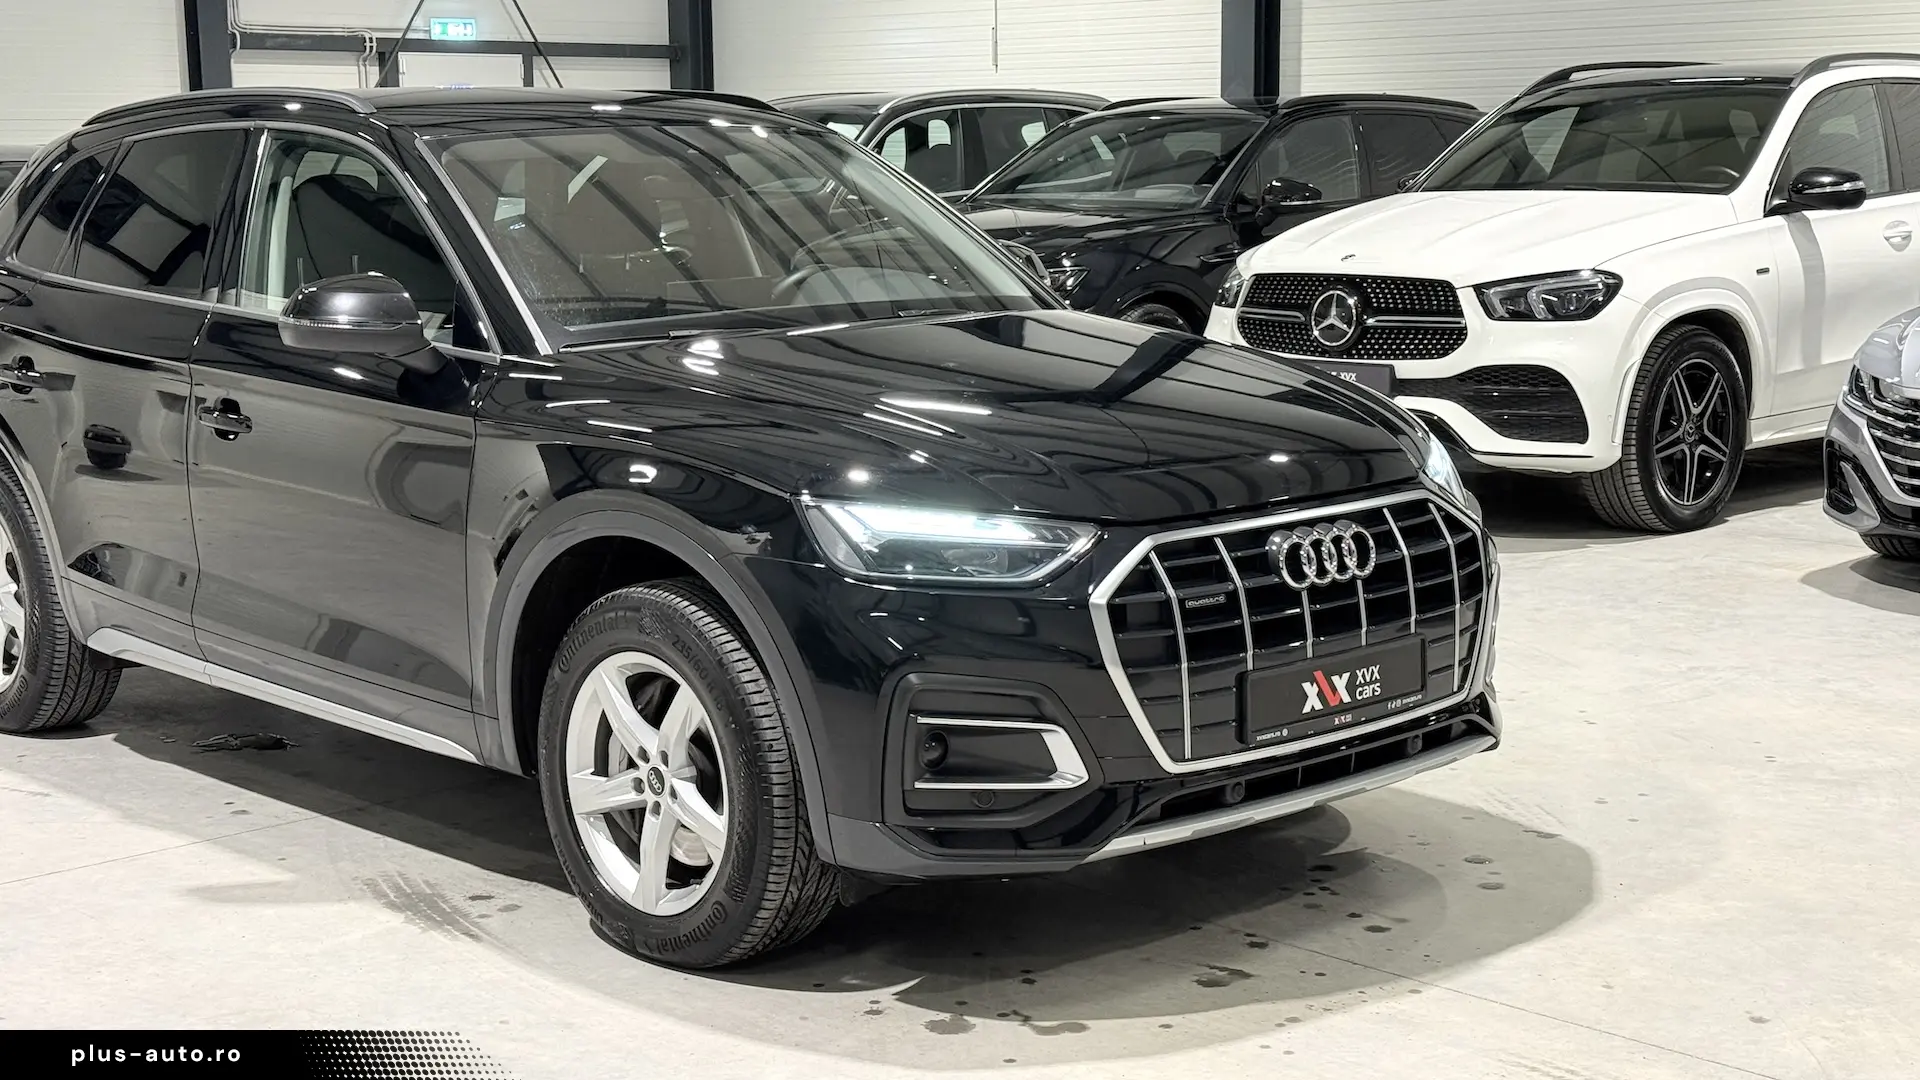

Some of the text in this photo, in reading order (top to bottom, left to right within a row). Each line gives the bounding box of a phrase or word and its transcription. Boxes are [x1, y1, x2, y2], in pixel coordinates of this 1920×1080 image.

[557, 611, 619, 674] Continental
[1355, 664, 1381, 686] XVX
[1355, 682, 1382, 701] cars
[655, 900, 729, 956] Continental
